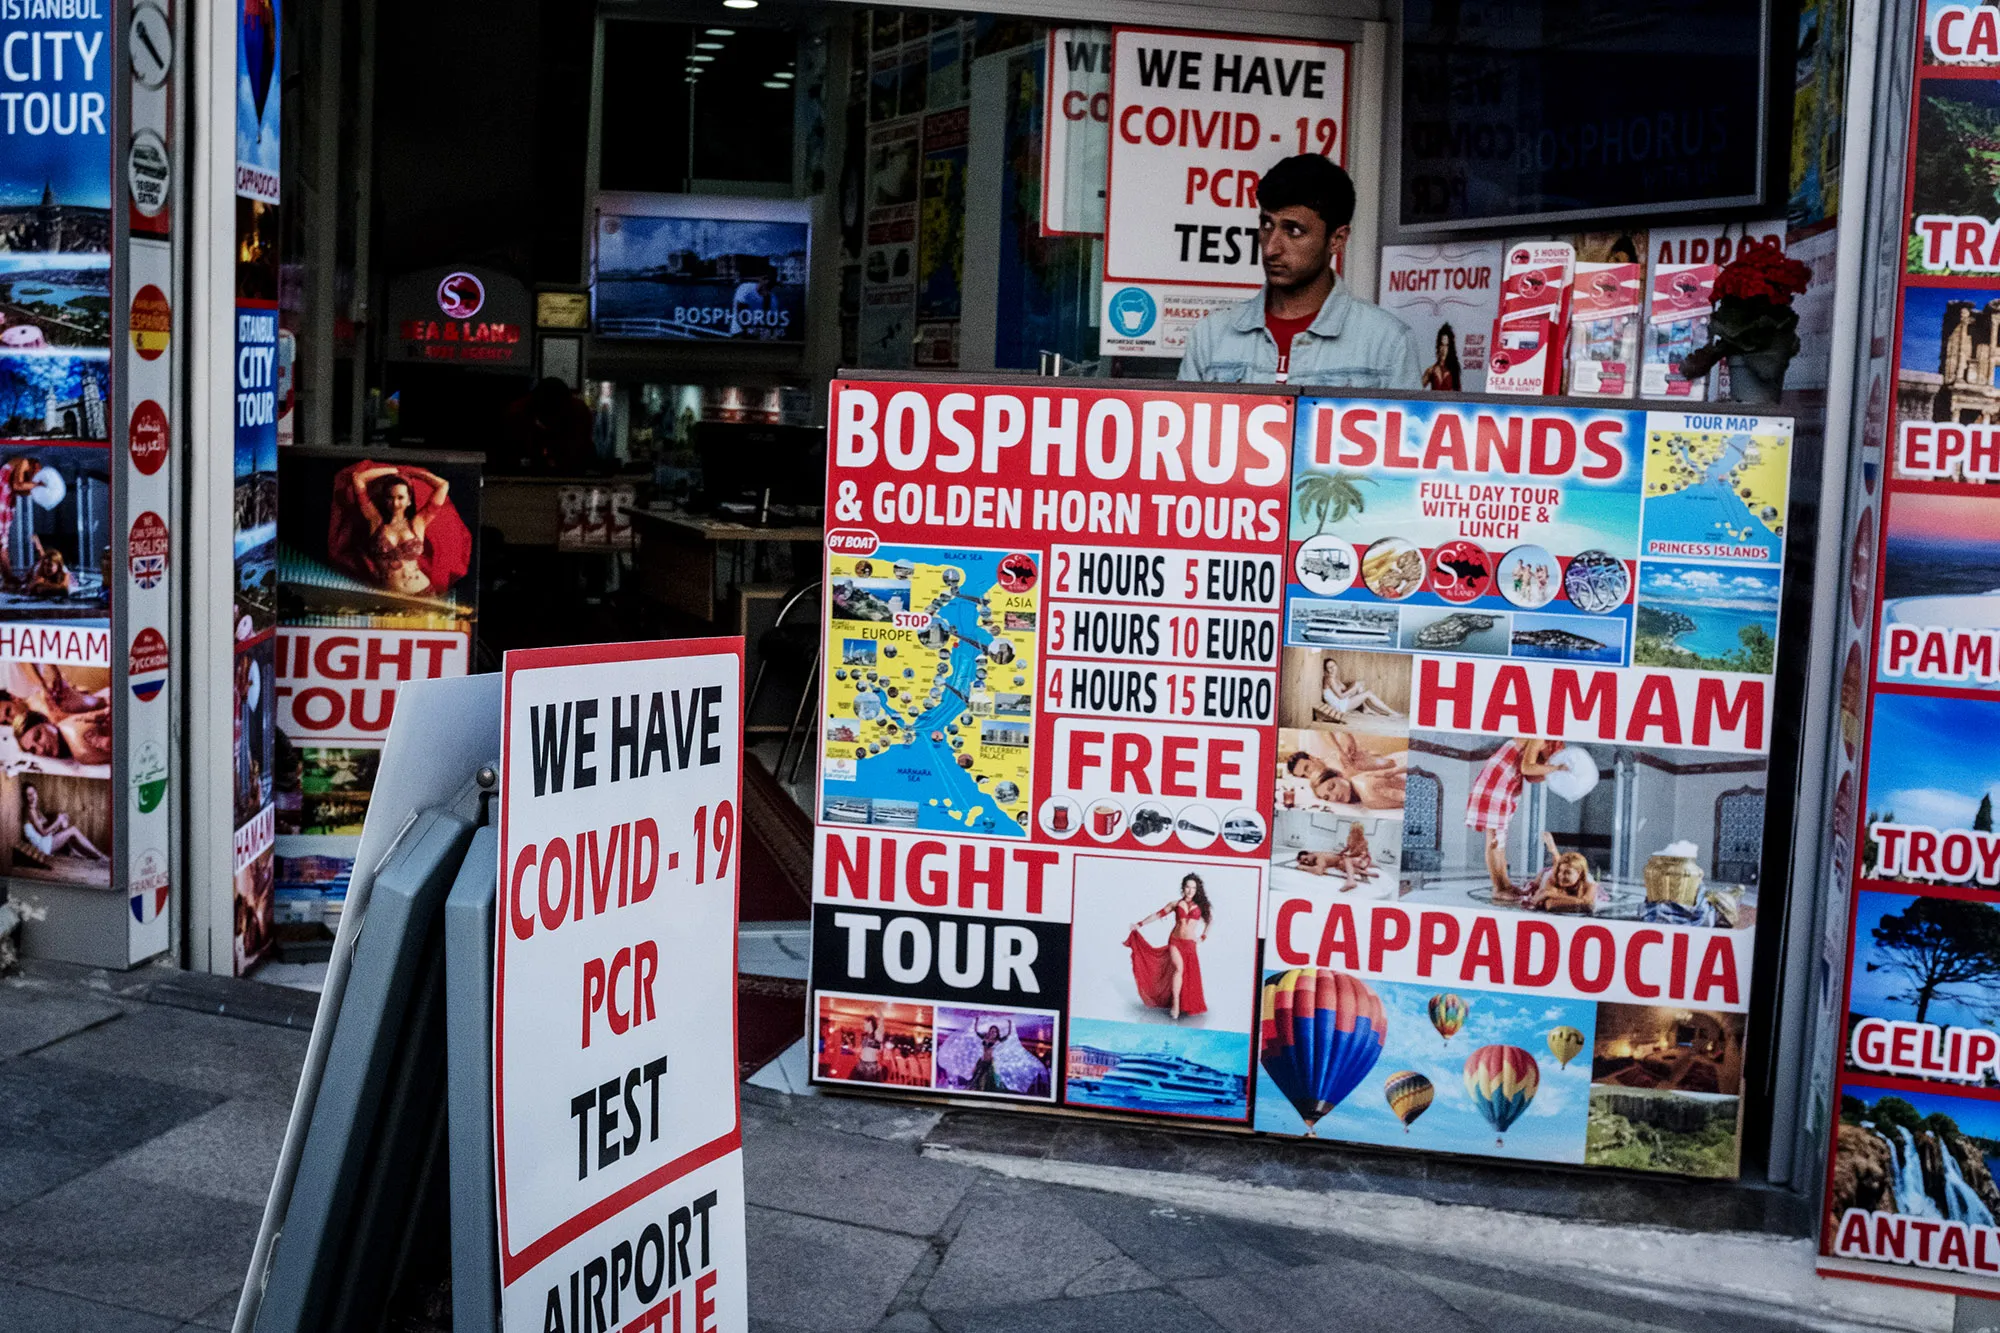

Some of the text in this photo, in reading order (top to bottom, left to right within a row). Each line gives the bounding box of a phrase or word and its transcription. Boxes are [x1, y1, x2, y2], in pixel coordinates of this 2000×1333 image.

[1, 0, 102, 19] ISTANBUL
[1937, 11, 1999, 56] CA
[3, 31, 103, 81] CITY
[1138, 47, 1326, 100] WE HAVE
[1, 92, 106, 135] TOUR
[1120, 105, 1260, 151] COIVID
[1295, 117, 1338, 156] 19
[1186, 167, 1260, 209] PCR
[1389, 266, 1491, 292] NIGHT TOUR
[674, 306, 790, 328] BOSPHORUS
[1164, 307, 1200, 318] MASKS
[238, 346, 275, 389] CITY
[1489, 376, 1507, 386] SEA
[1519, 378, 1542, 387] LAND
[238, 391, 275, 427] TOUR
[1684, 415, 1758, 431] TOUR MAP
[836, 389, 1287, 487] BOSPHORUS
[1314, 408, 1623, 479] ISLANDS
[1905, 427, 2000, 473] EPH
[834, 480, 1280, 542] & GOLDEN HORN TOURS
[1420, 482, 1559, 505] FULL DAY TOUR
[1423, 501, 1549, 523] WITH GUIDE &
[829, 536, 877, 549] BY BOAT
[1459, 520, 1519, 539] LUNCH
[1650, 542, 1768, 558] PRINCESS ISLANDS
[1056, 551, 1274, 603] 2 HOURS 5 EURO
[895, 614, 929, 628] STOP
[1005, 597, 1032, 608] ASIA
[0, 627, 108, 663] HAMAM
[862, 628, 912, 642] EUROPE
[1051, 609, 1274, 662] 3 HOURS 10 EURO
[276, 686, 396, 732] OU
[1049, 668, 1271, 720] 4 HOURS 15 EURO
[1417, 659, 1764, 749] HAMAM
[530, 685, 722, 797] WE HAVE
[1068, 730, 1243, 800] FREE
[235, 807, 273, 870] HAMAM
[1877, 827, 2000, 879] TROY
[510, 817, 659, 940] COIVID
[693, 799, 734, 885] 19
[824, 834, 1059, 914] NIGHT
[834, 912, 1040, 994] TOUR
[1276, 898, 1740, 1005] CAPPADOCIA
[582, 940, 657, 1050] PCR
[1858, 1023, 1996, 1075] GELIP
[571, 1055, 667, 1181] TEST
[543, 1189, 717, 1333] AIRPORT
[1841, 1214, 1999, 1272] ANTAL
